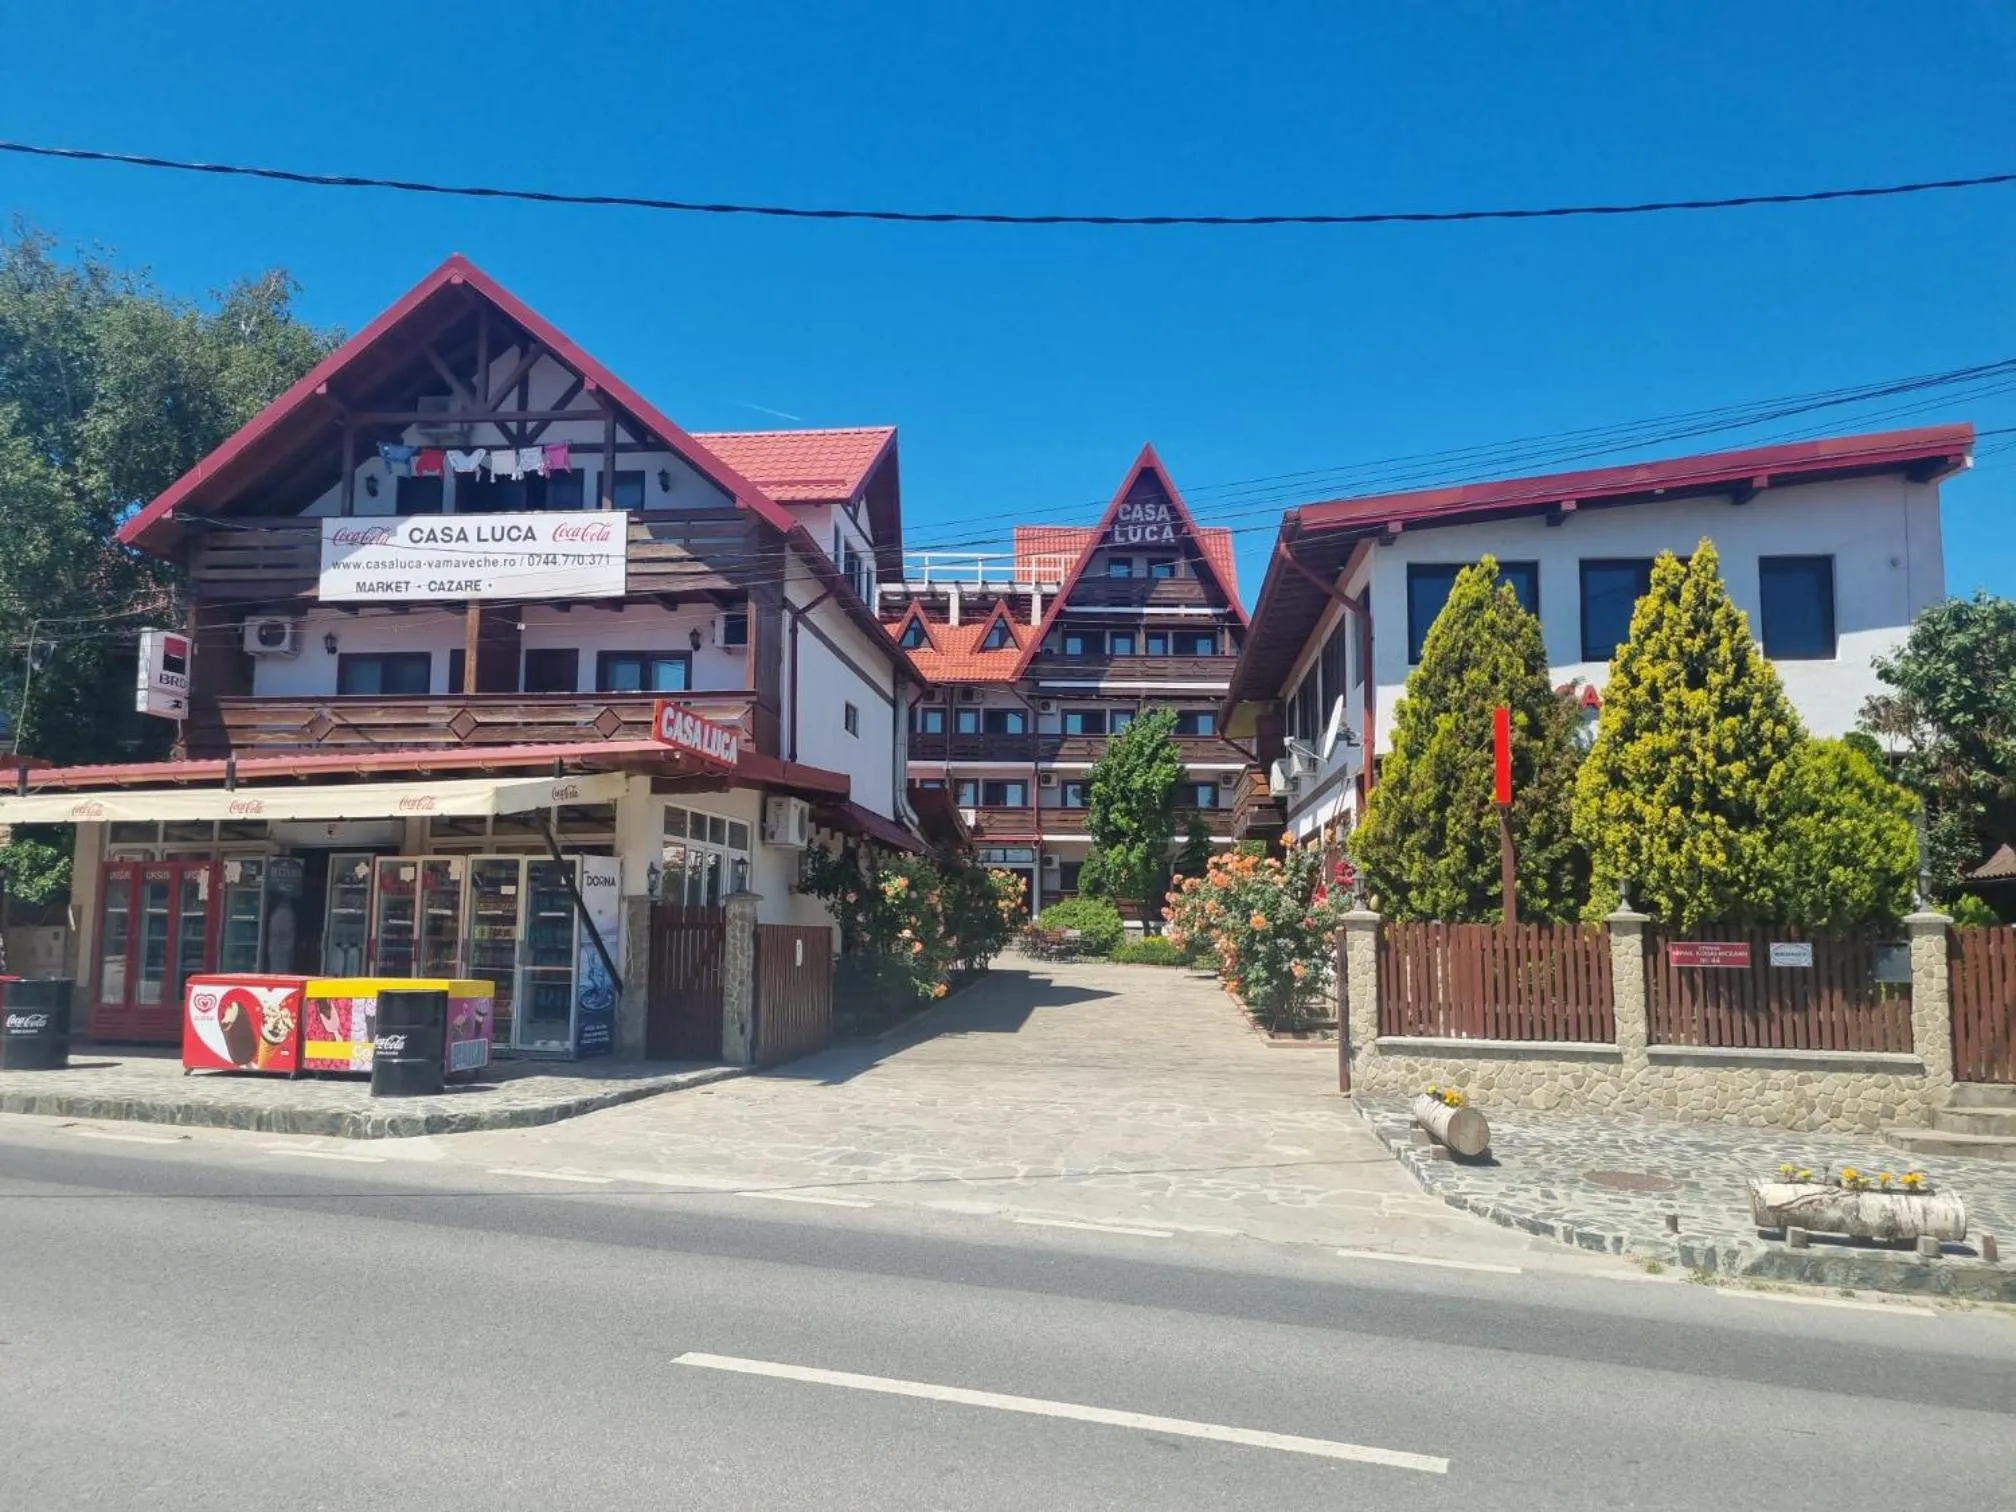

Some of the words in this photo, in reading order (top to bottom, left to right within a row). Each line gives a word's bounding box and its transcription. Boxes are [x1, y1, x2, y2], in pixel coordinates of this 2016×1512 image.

[1118, 503, 1171, 521] CASA
[408, 526, 470, 544] CASA
[476, 524, 537, 543] LUCA
[1114, 524, 1176, 542] LUCA
[331, 556, 516, 570] www.casaluca-vamaveche.ro
[355, 580, 411, 593] MARKET
[428, 579, 483, 592] CAZARE
[661, 706, 702, 751] CASA
[702, 724, 738, 765] LUCA
[586, 874, 616, 888] DORNA
